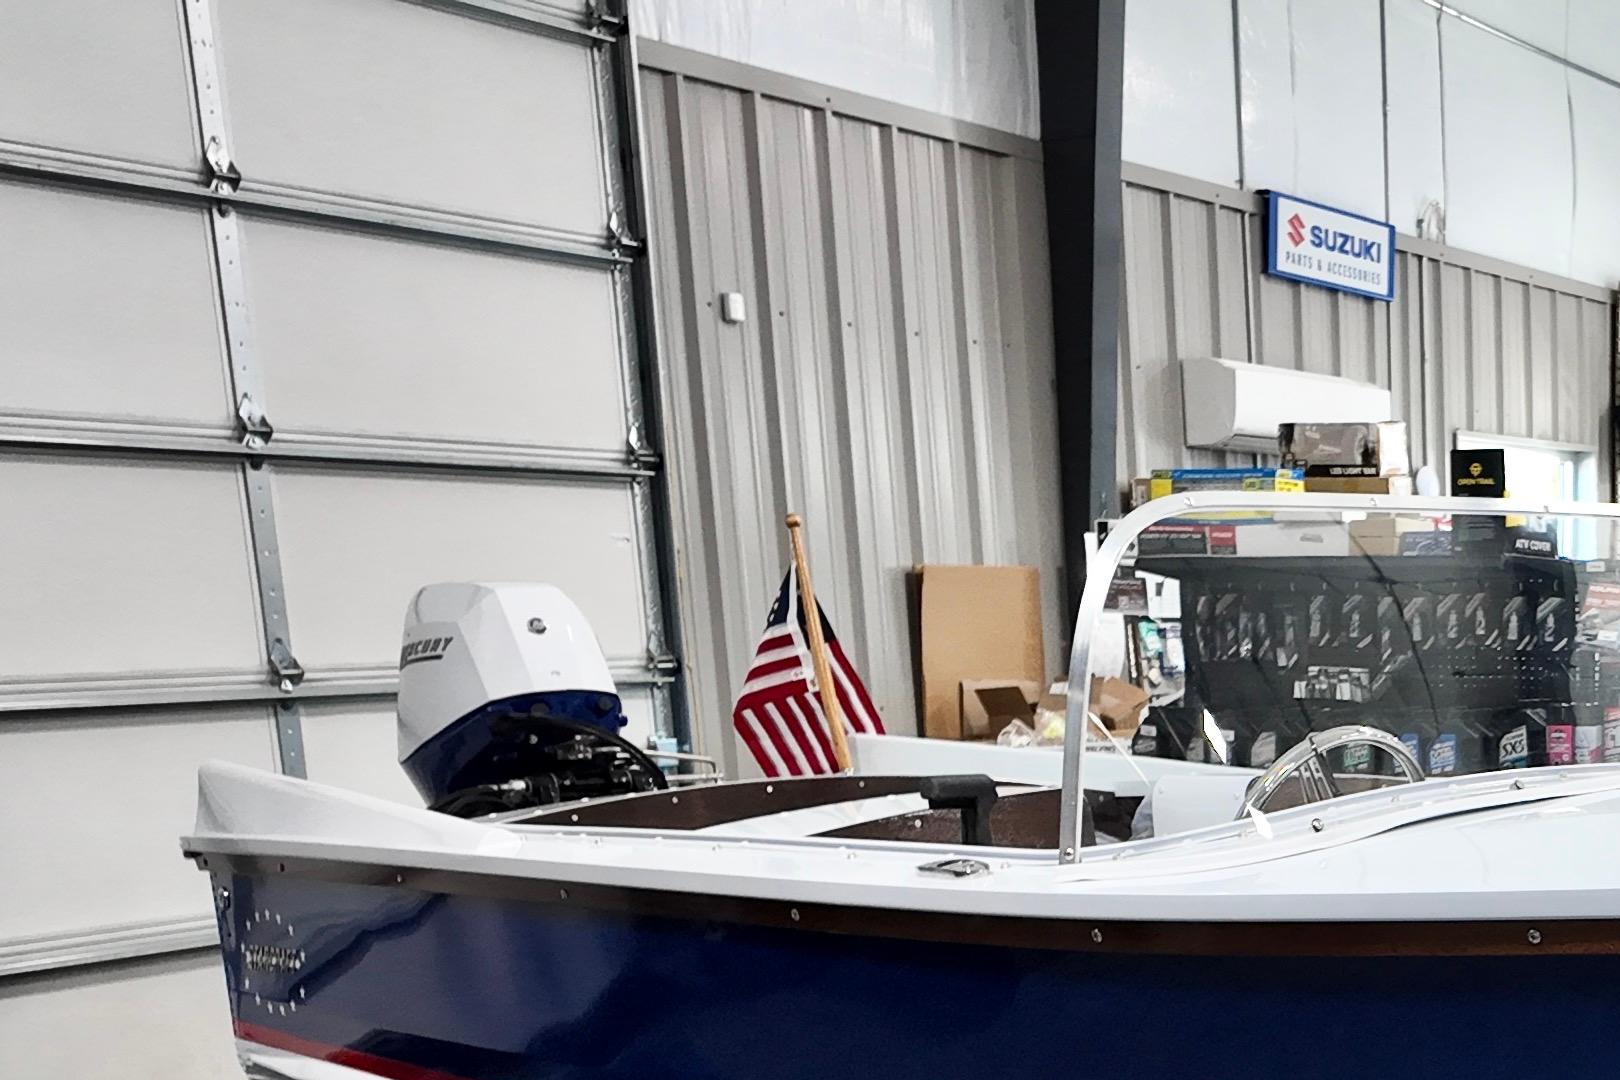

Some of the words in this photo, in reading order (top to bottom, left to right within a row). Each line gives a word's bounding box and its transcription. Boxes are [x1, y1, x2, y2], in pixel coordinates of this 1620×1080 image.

[1310, 225, 1382, 264] SUZUKI
[1285, 251, 1313, 270] PARTS
[1327, 261, 1382, 286] ACCESSORIES
